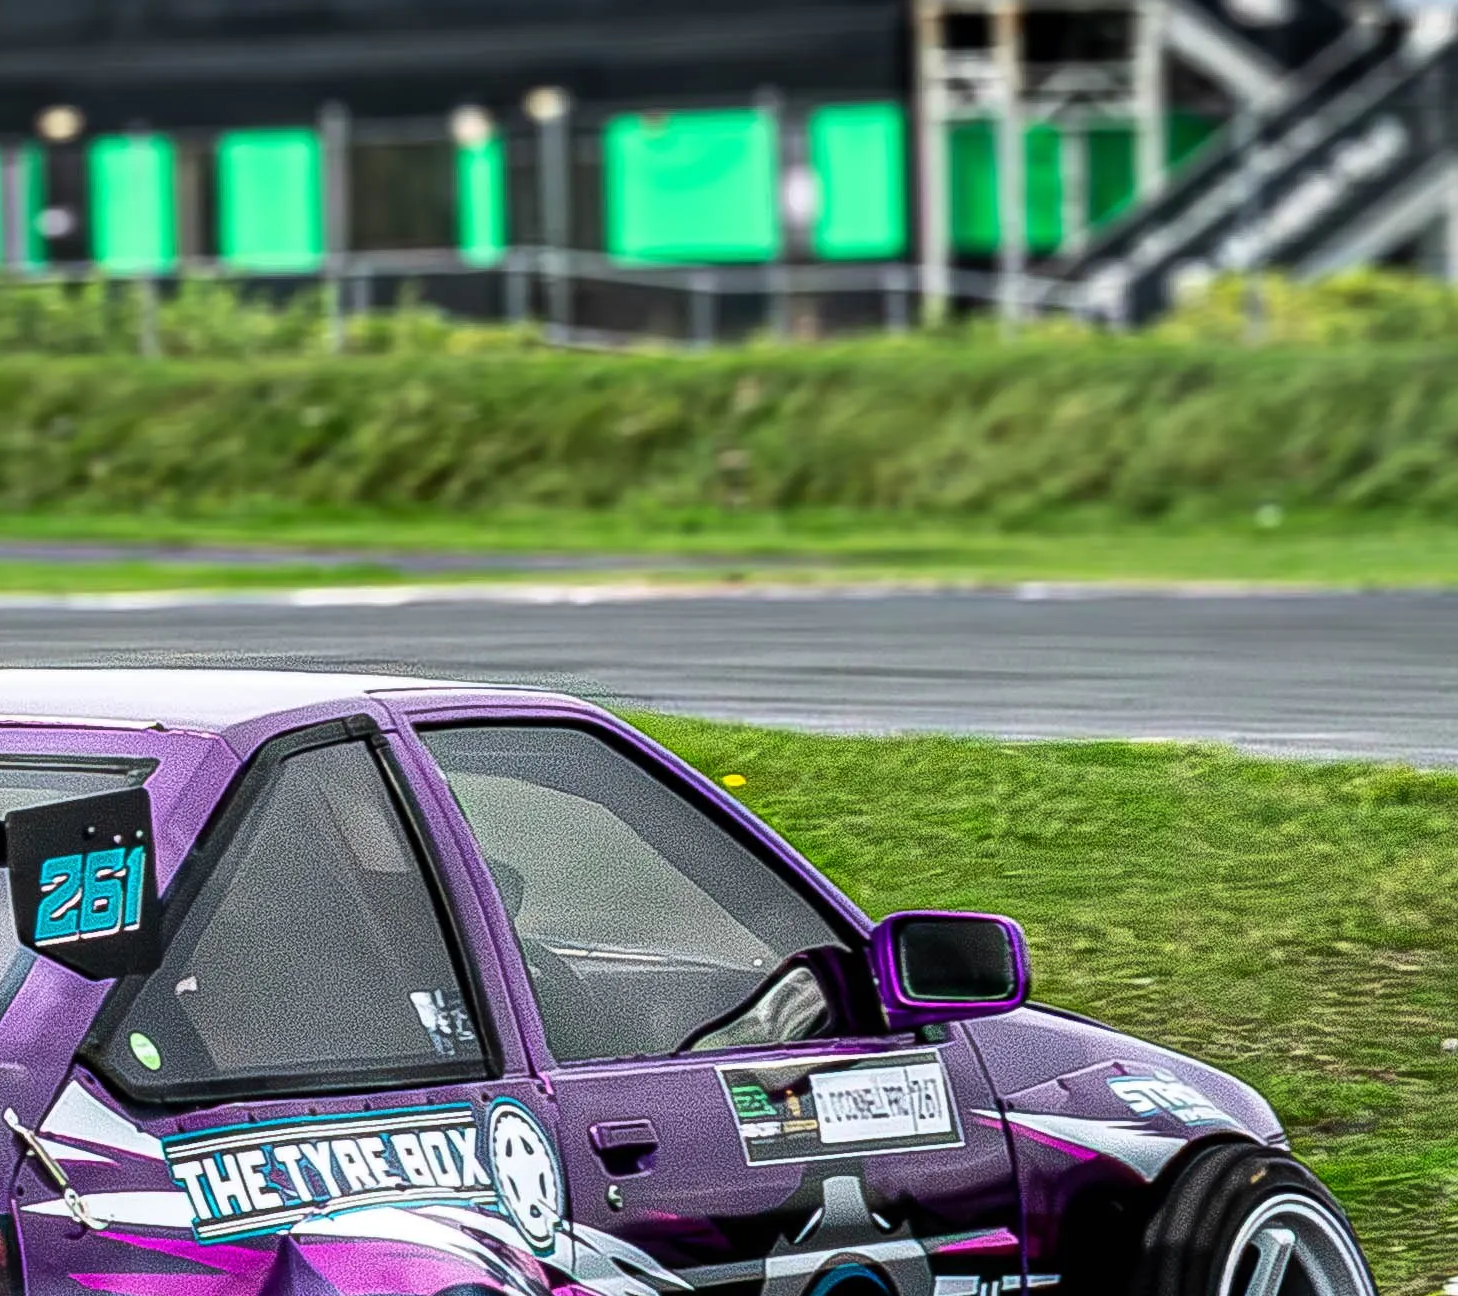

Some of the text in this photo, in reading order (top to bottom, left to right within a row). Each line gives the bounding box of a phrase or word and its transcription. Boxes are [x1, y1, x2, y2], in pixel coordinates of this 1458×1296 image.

[34, 845, 146, 947] 261
[171, 1126, 493, 1221] THE TYRE BOX
